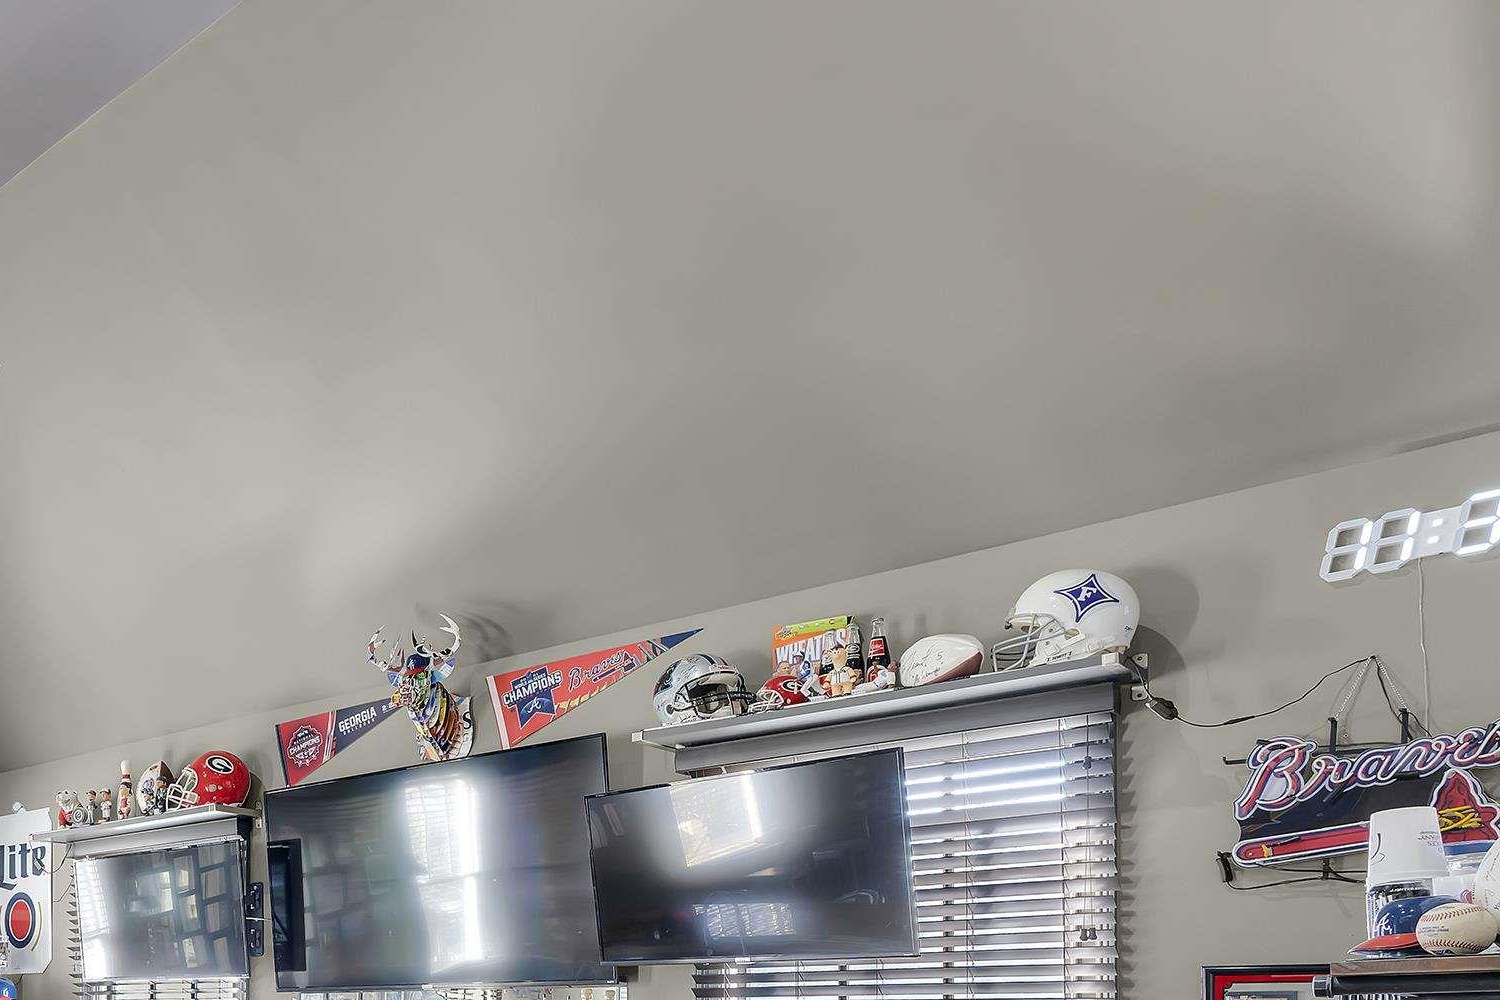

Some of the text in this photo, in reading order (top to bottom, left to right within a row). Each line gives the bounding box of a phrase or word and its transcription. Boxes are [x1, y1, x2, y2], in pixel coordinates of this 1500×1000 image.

[1077, 586, 1098, 602] F
[569, 651, 626, 692] Braves
[503, 671, 561, 705] CHAMPIONS
[339, 706, 377, 732] GEORGIA
[289, 735, 321, 755] CHAMPIONS
